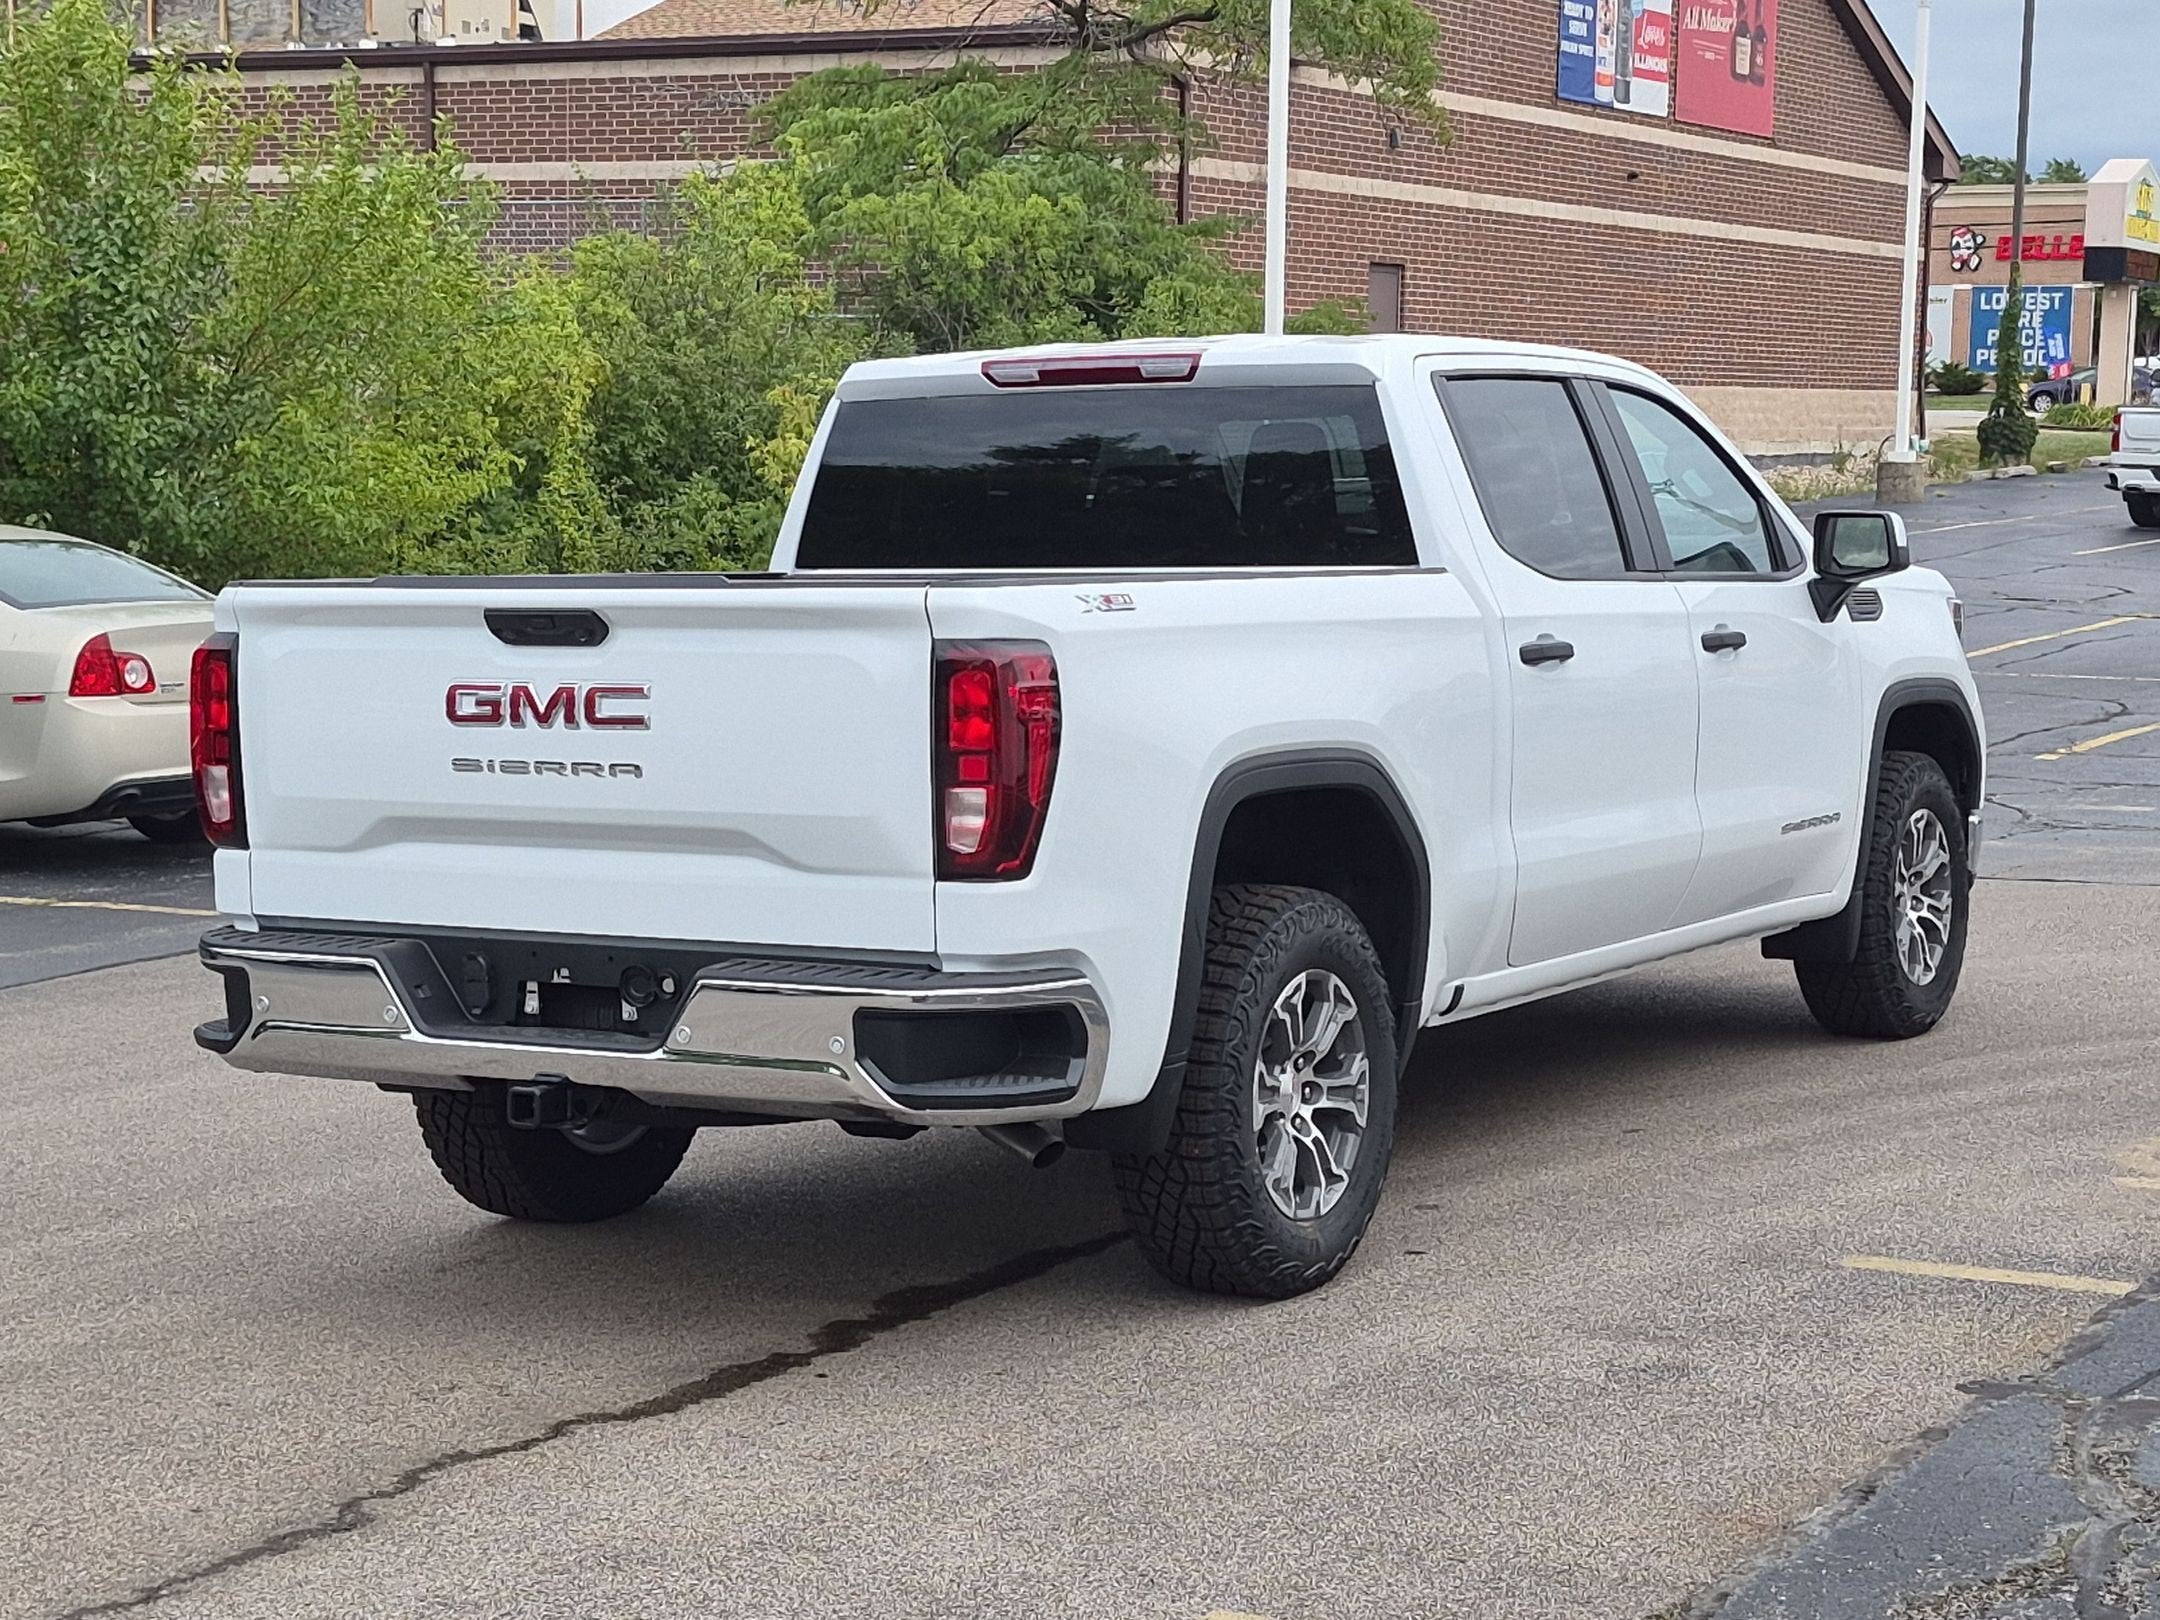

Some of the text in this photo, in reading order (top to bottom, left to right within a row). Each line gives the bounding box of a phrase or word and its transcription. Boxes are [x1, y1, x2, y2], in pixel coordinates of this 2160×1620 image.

[1683, 5, 1700, 30] All
[1633, 52, 1668, 74] ILLINOIS
[1980, 292, 2064, 310] LOEST
[1986, 329, 2046, 347] PCE
[445, 681, 651, 731] GMC
[451, 757, 644, 779] SIERRA
[1780, 811, 1841, 835] SIERRA
